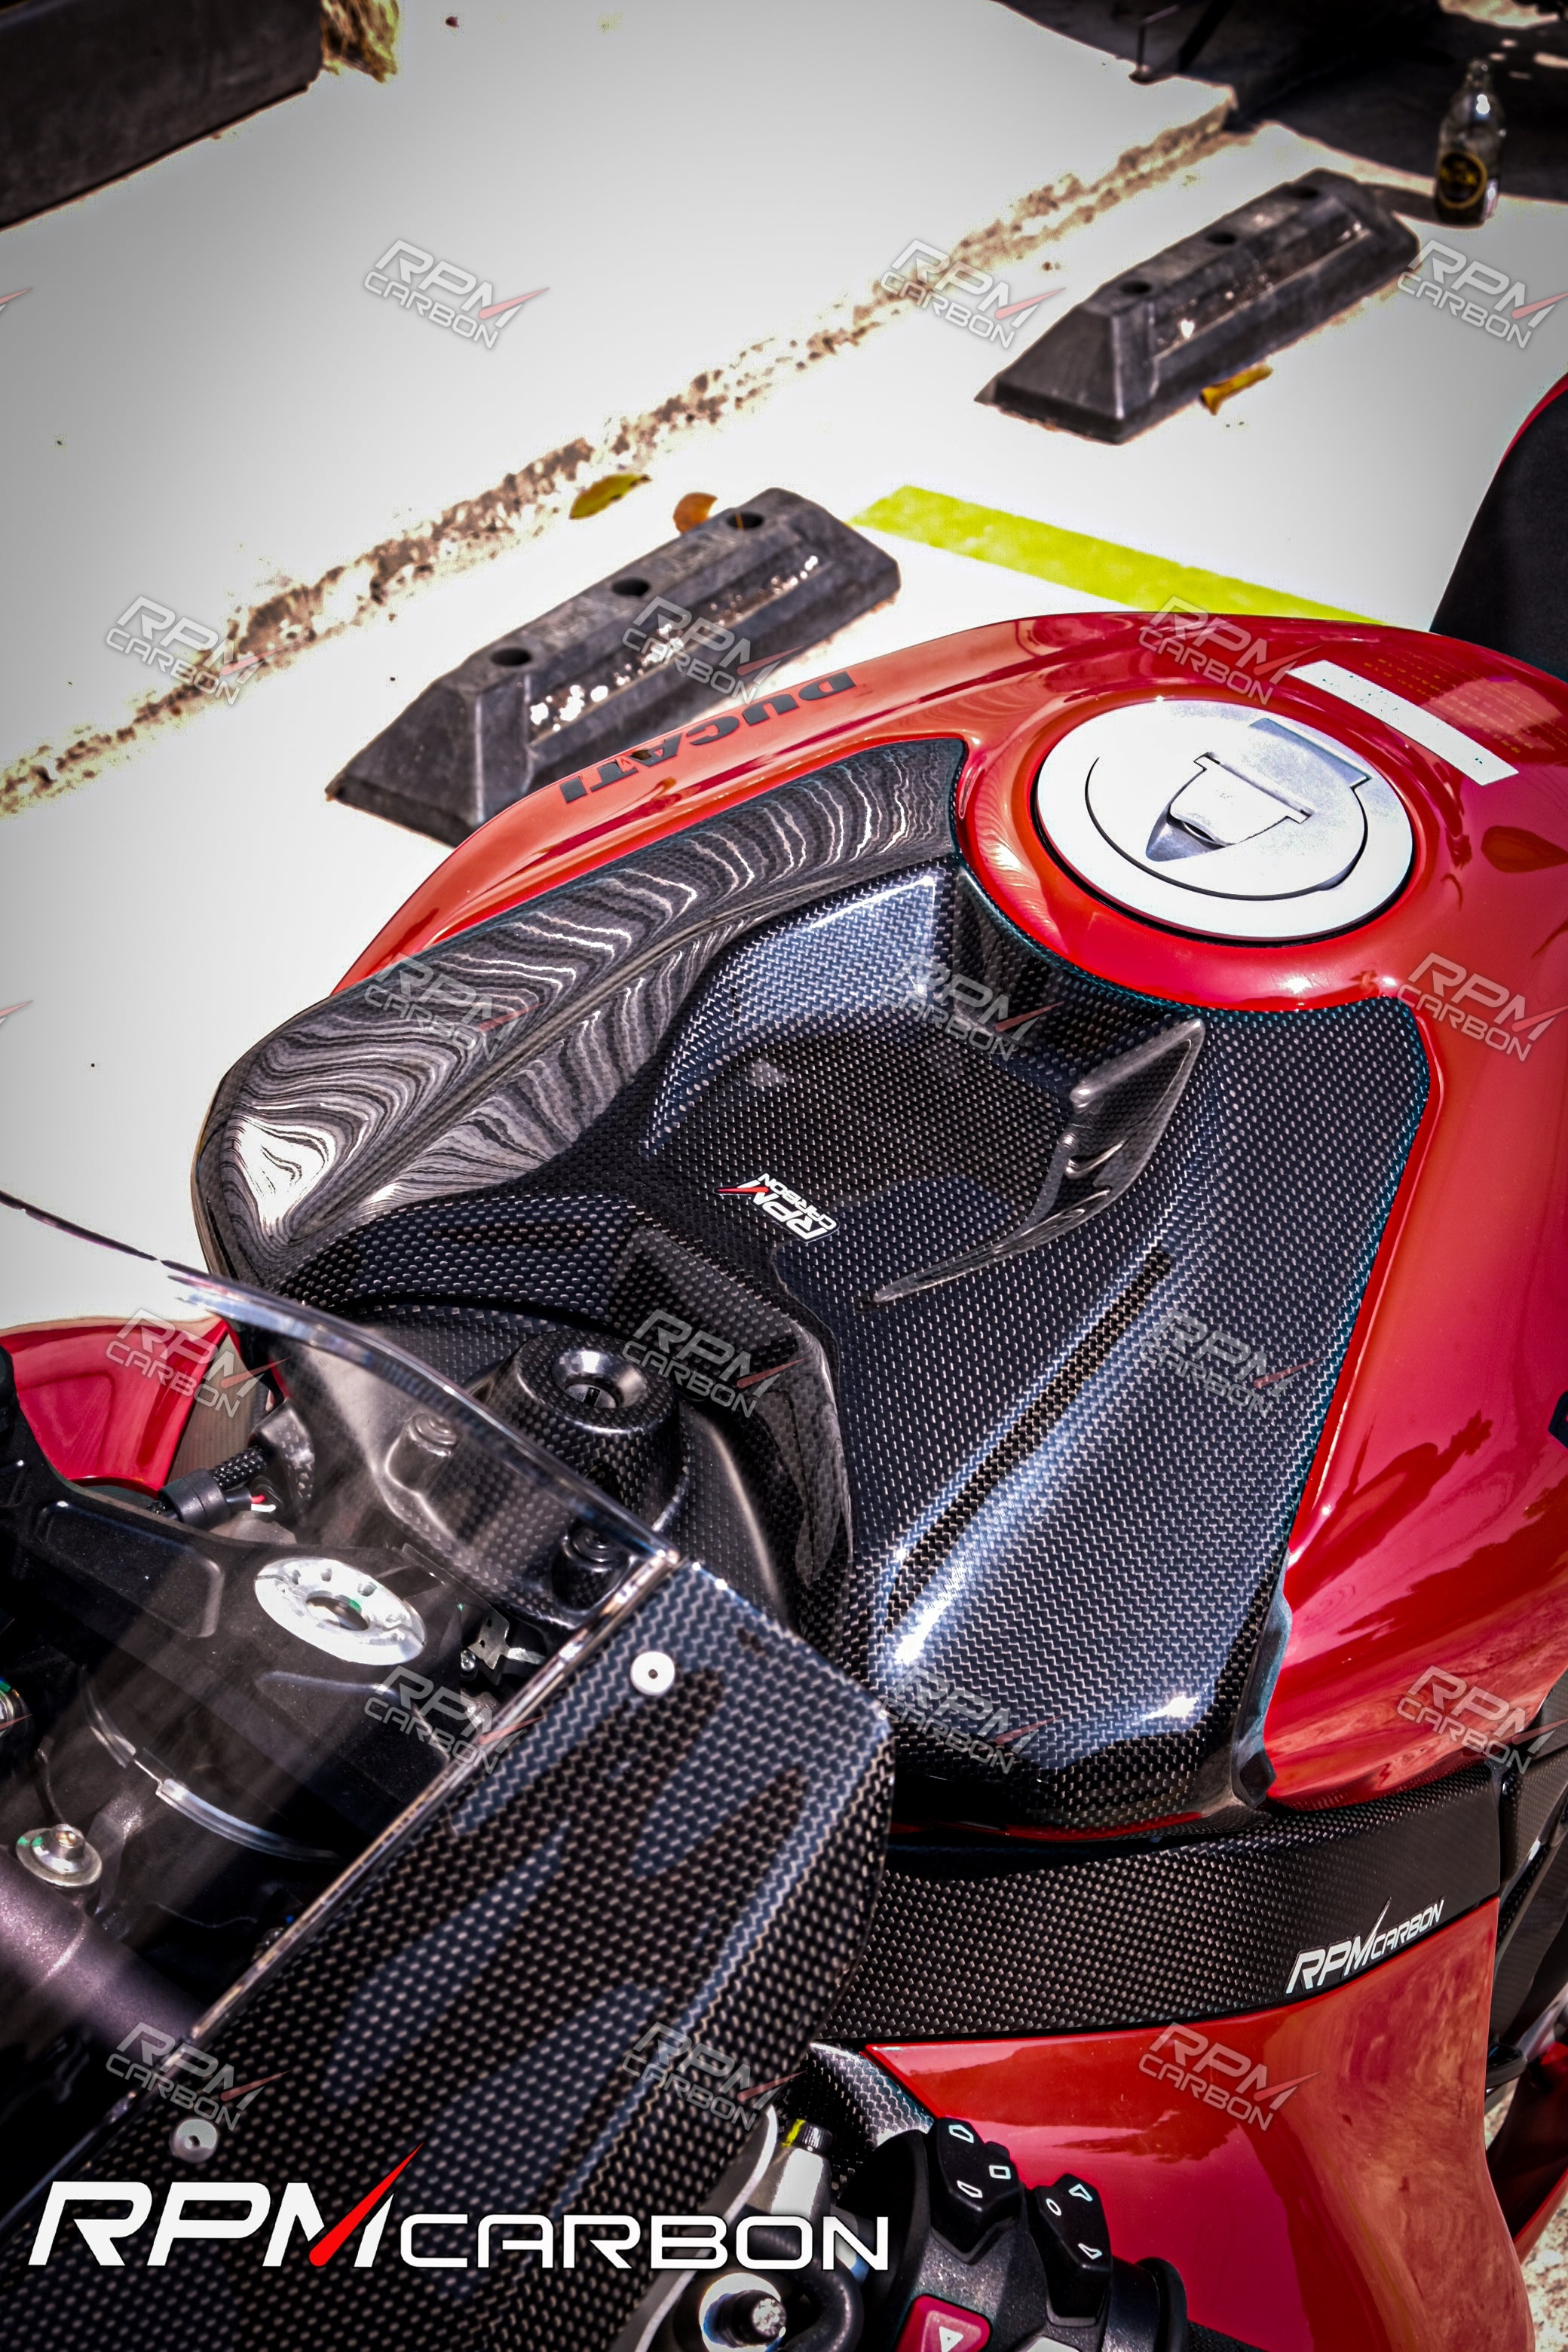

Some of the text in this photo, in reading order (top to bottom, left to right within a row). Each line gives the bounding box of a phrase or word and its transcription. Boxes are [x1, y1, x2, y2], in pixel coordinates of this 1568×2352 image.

[559, 671, 856, 804] DUCATI
[718, 1180, 828, 1239] RPM
[758, 1173, 837, 1230] CARBON
